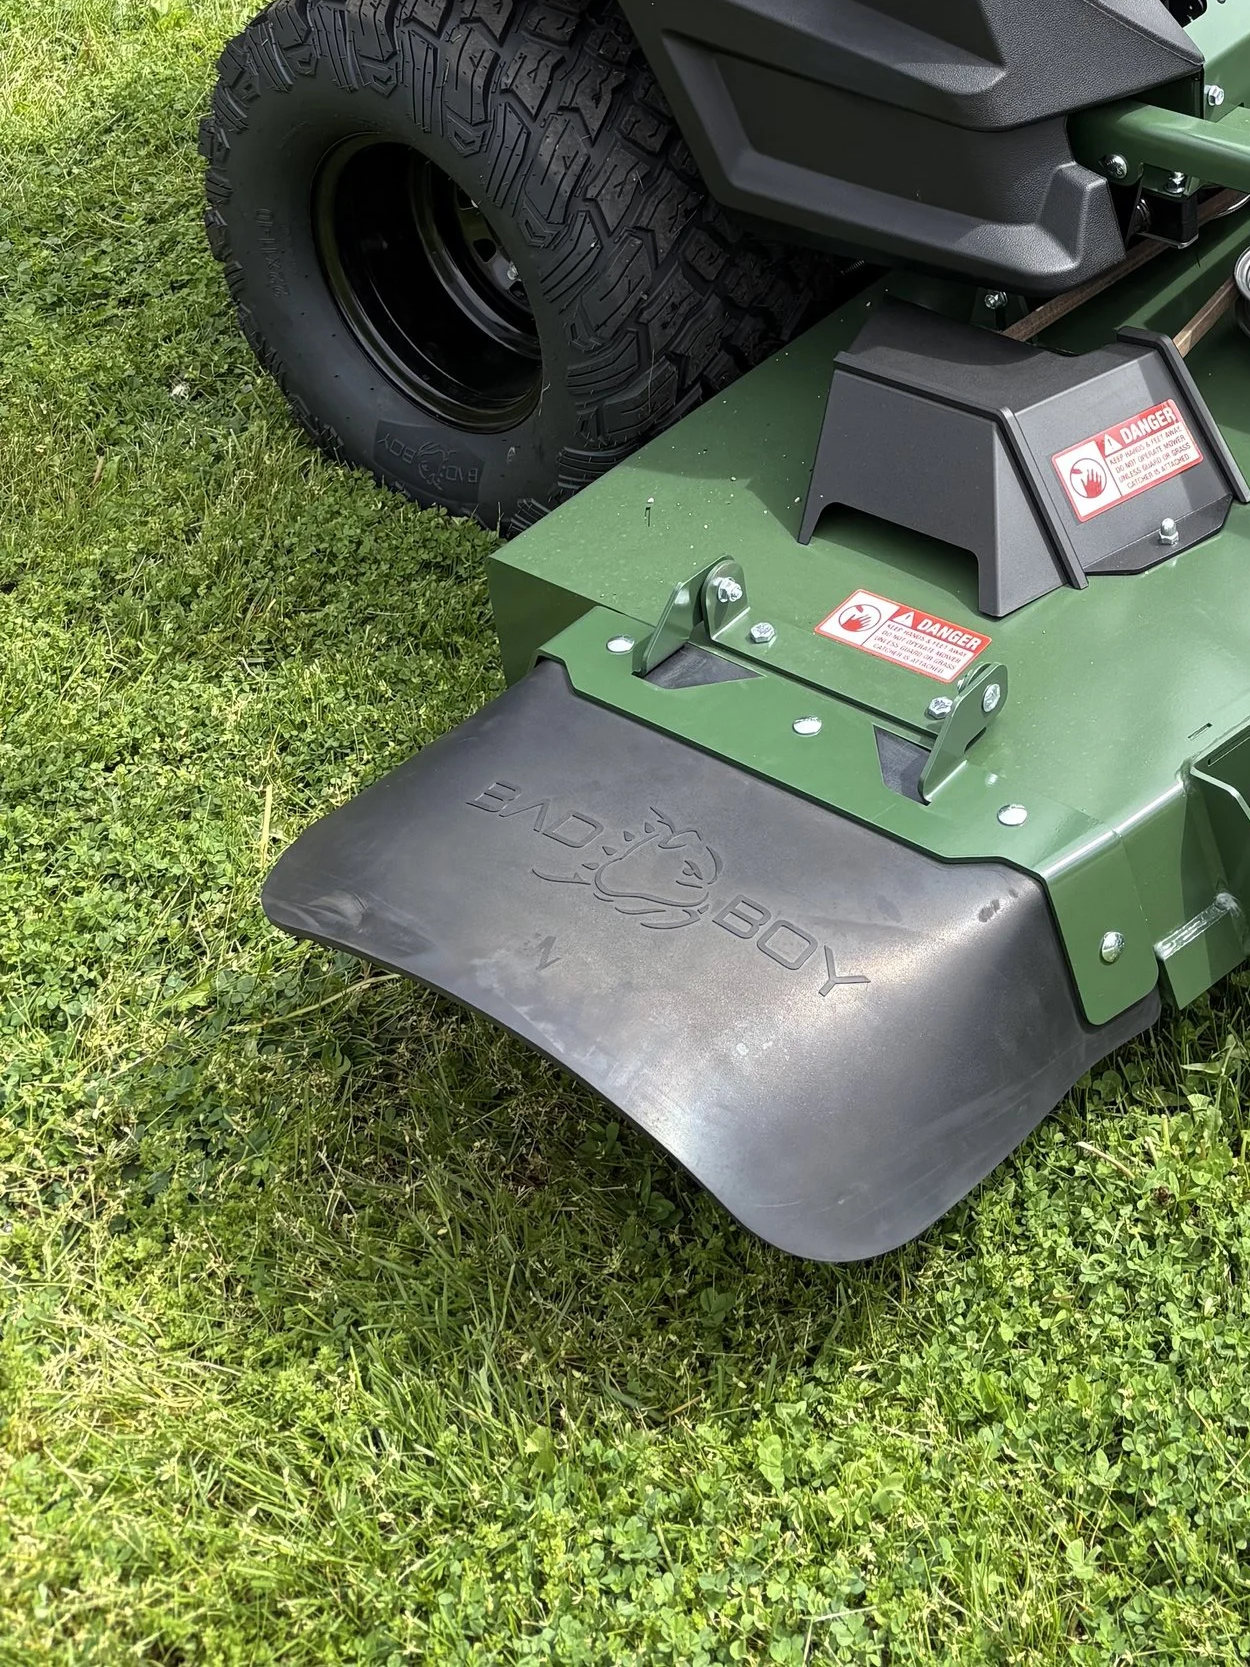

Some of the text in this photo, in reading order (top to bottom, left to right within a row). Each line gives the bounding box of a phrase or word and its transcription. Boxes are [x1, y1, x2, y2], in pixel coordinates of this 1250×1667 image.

[1119, 407, 1176, 443] DANGER
[1109, 454, 1124, 465] KEEP
[1125, 444, 1144, 457] HANDS
[1150, 434, 1164, 444] FEET
[1115, 434, 1185, 473] DO NOT OPERATE MOWER
[1118, 442, 1190, 483] UNLESS GUARD OR GRASS
[1127, 471, 1153, 489] CATCHER
[886, 624, 903, 632] KEEP
[903, 630, 925, 640] HANDS
[931, 641, 947, 649] FEET
[916, 619, 983, 649] DANGER
[872, 643, 902, 657] CATCHER
[874, 636, 900, 647] UNLESS
[899, 645, 922, 656] GUARD
[932, 659, 955, 670] GRASS
[905, 639, 934, 653] OPERATE
[934, 651, 961, 663] MOWER
[465, 781, 872, 998] BAD BOY
